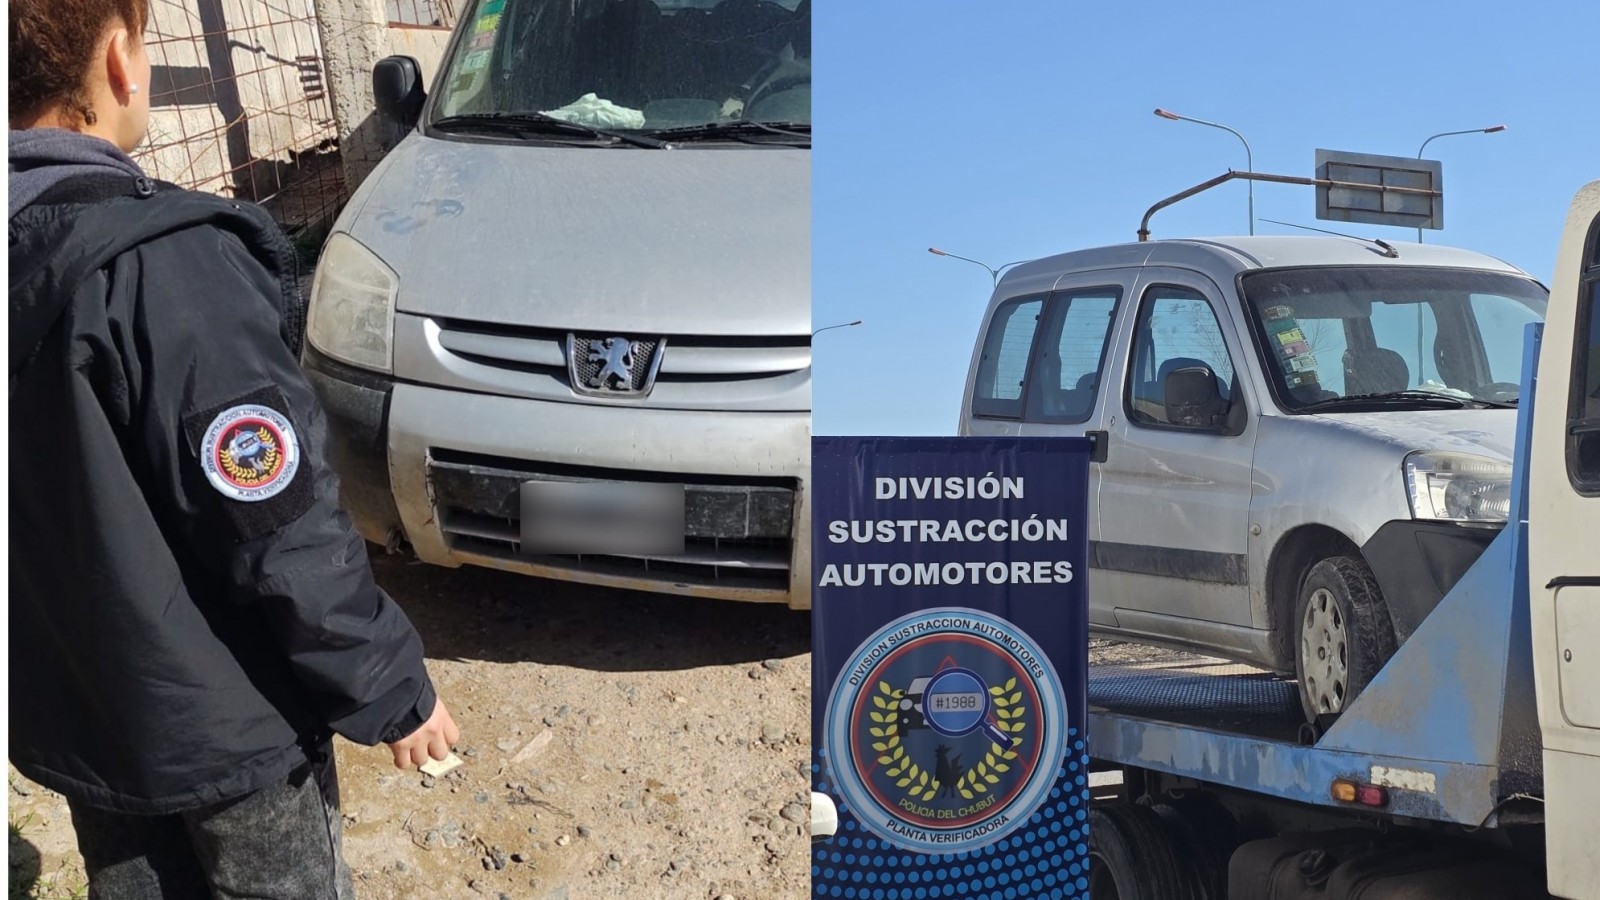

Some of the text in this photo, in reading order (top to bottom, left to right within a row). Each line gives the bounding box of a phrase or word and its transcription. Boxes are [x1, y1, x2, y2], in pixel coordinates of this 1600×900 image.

[875, 472, 1024, 499] DIVISIÓN
[828, 514, 1068, 543] SUSTRACCIÓN
[818, 561, 1073, 587] AUTOMOTORES
[849, 618, 1044, 686] DIVISION SUSTRACCION AUTOMOTORES
[935, 696, 976, 709] #1988
[899, 794, 996, 819] POLICIA DEL CHUBUT
[886, 815, 1009, 843] PLANTA VERIFICADORA
